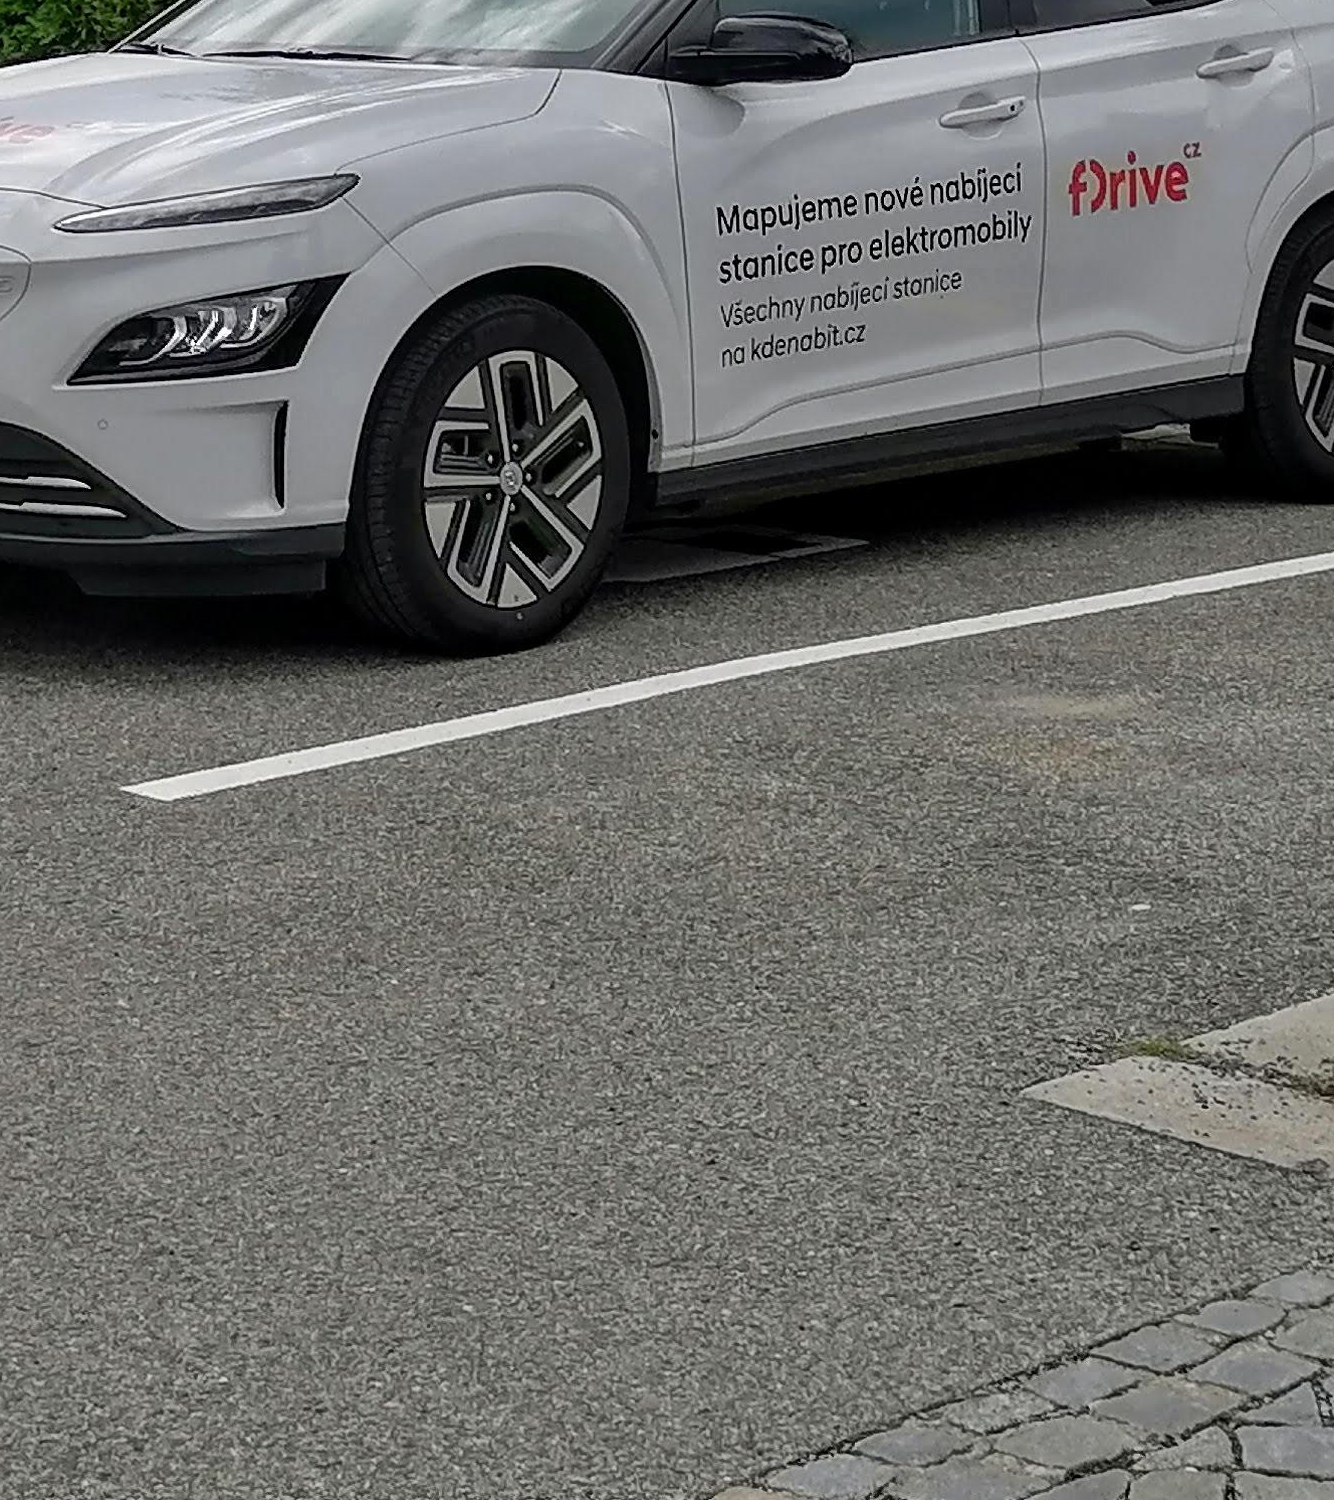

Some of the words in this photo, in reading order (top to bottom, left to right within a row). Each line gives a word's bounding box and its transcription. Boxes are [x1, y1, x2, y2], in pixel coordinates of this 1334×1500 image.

[717, 194, 858, 236] Mapujeme
[865, 177, 924, 214] nové
[719, 244, 814, 284] stanice
[821, 241, 862, 274] pro
[869, 210, 1032, 260] elektromobily
[721, 296, 805, 328] Všechny
[893, 269, 962, 299] stanice
[722, 347, 745, 368] na
